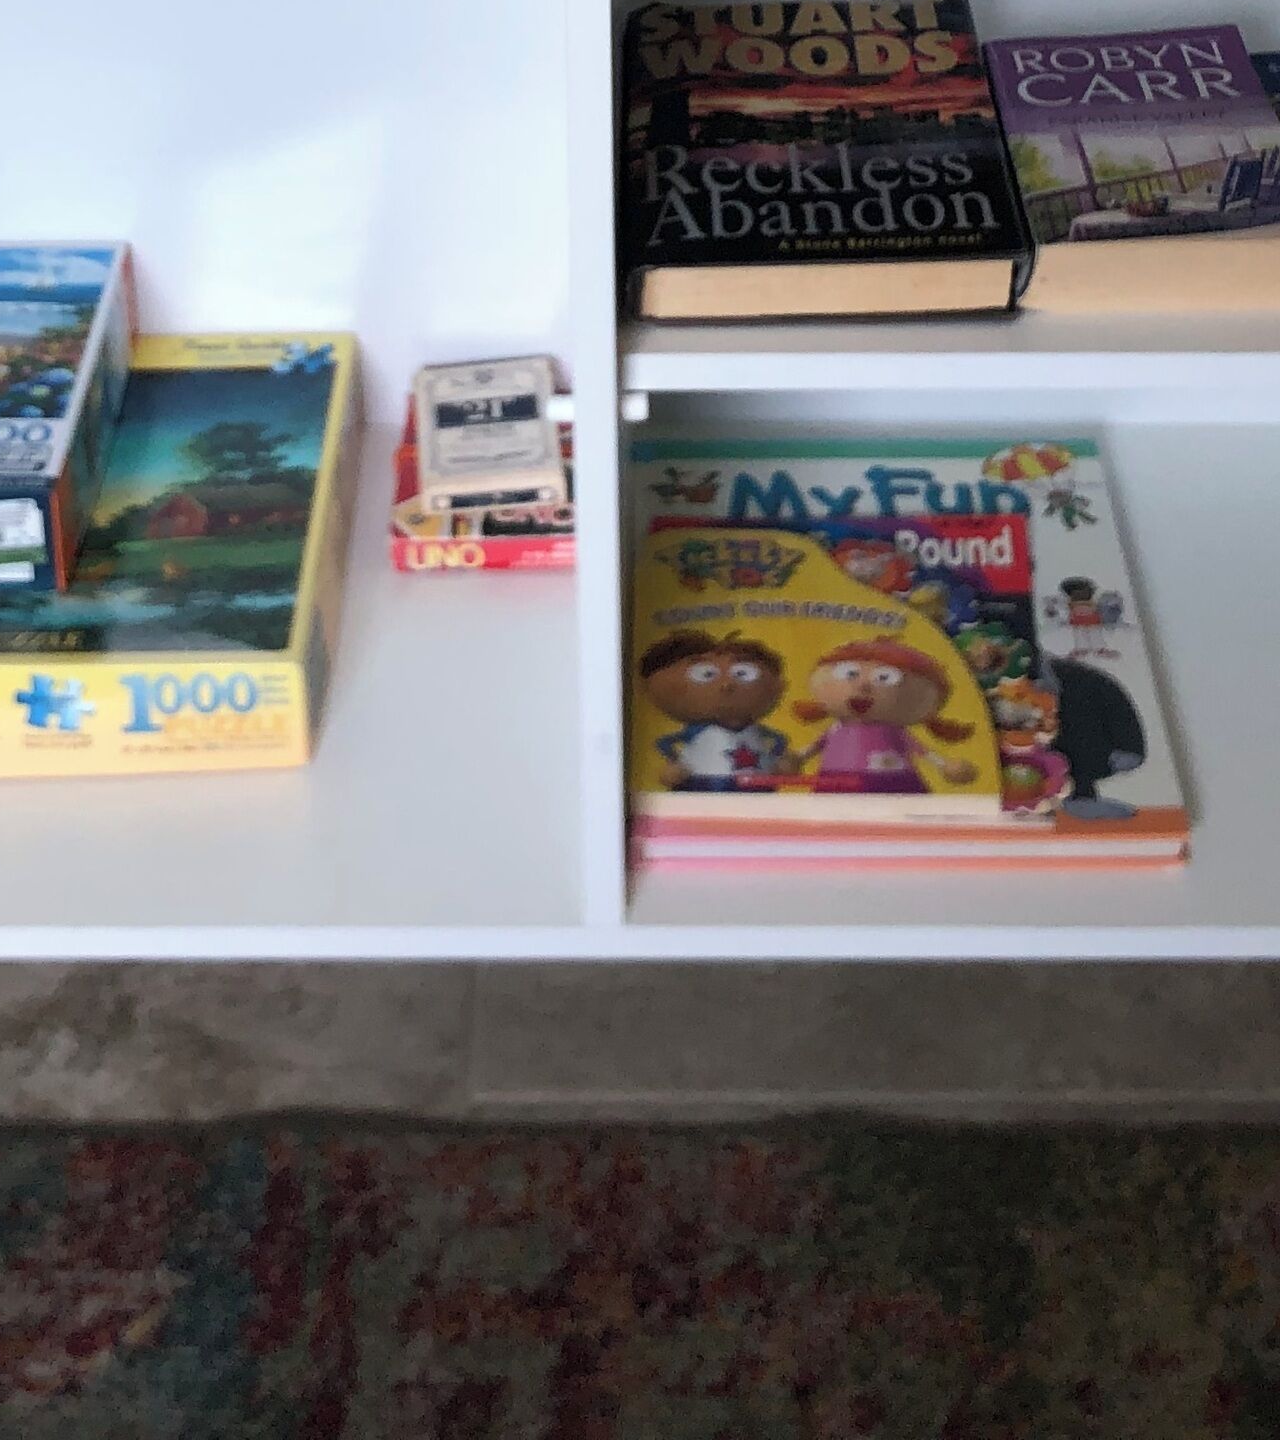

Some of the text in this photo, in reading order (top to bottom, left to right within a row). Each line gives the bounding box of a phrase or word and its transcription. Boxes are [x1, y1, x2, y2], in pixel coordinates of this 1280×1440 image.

[638, 29, 959, 80] WOODS
[1011, 38, 1225, 74] ROBYN
[1017, 66, 1241, 107] CARR
[642, 141, 975, 203] Reckless
[647, 182, 1000, 247] Abandon
[728, 464, 1032, 519] My Fun
[406, 539, 486, 571] UNO
[118, 671, 259, 733] 1000
